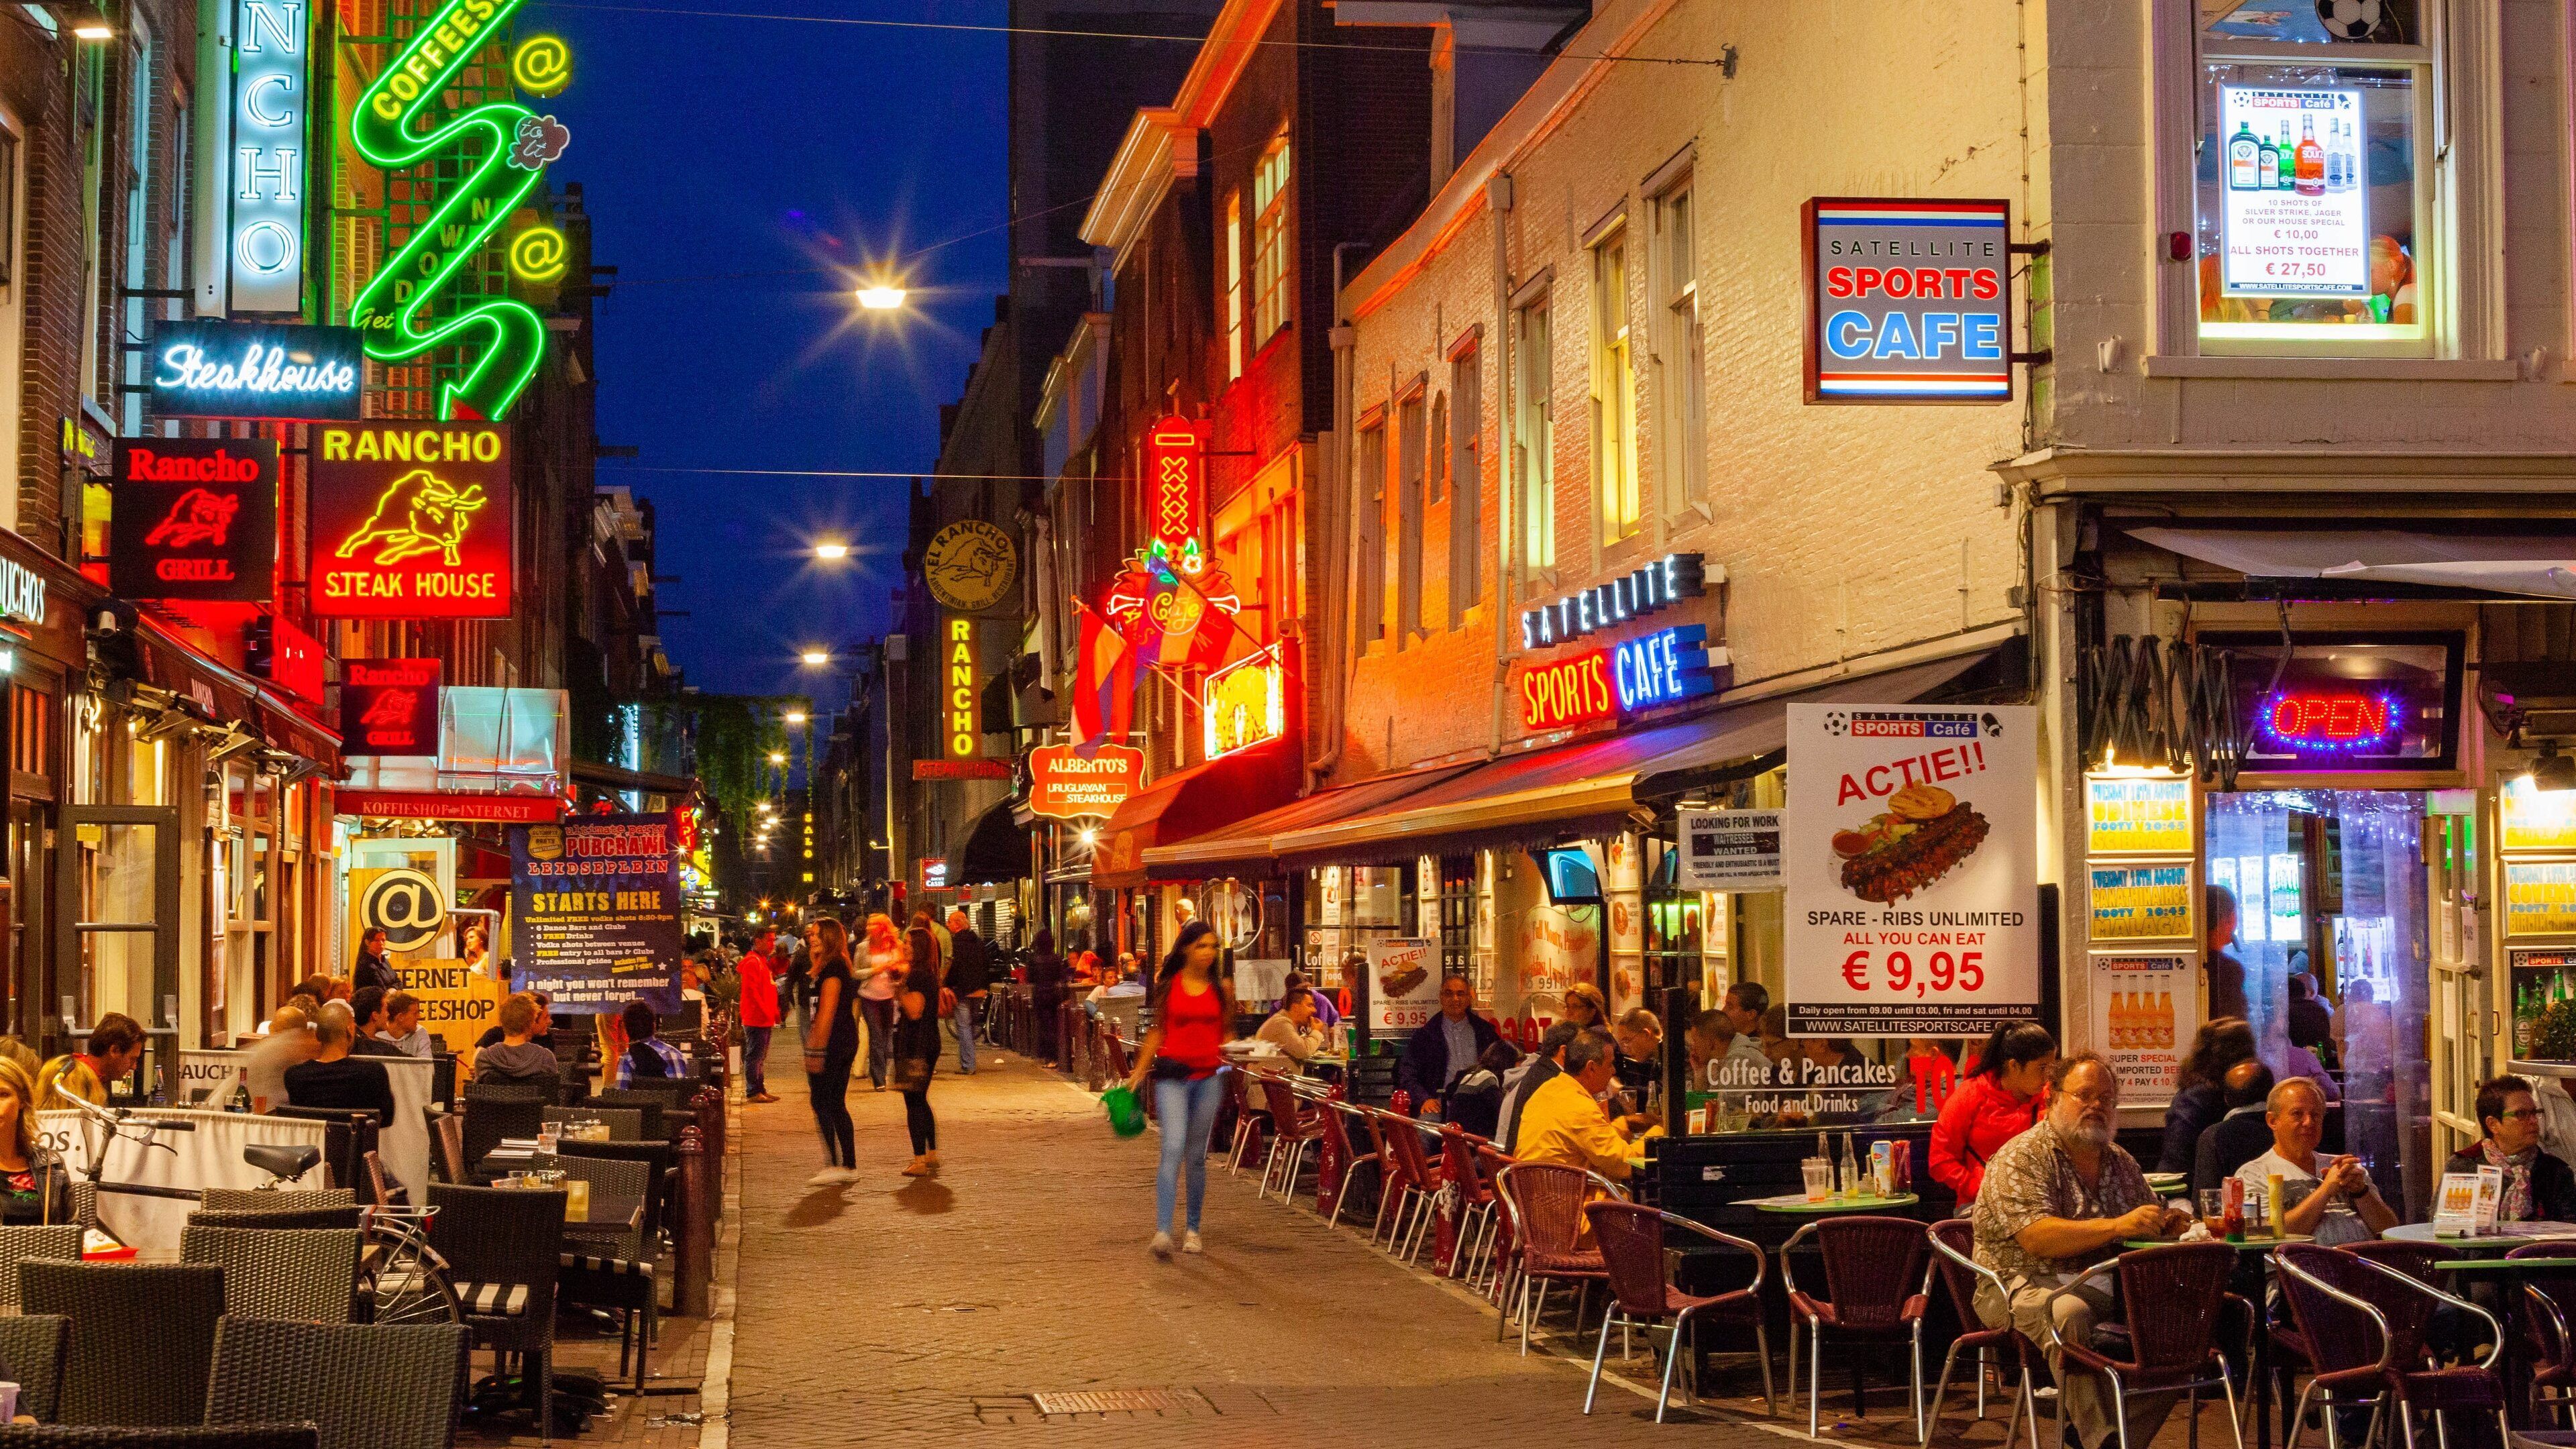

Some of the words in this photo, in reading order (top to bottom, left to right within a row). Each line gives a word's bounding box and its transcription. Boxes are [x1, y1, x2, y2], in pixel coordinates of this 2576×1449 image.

[372, 0, 504, 121] COFFEES
[2254, 99, 2299, 108] SPORTS
[2306, 99, 2331, 109] Café
[2279, 209, 2312, 217] STRIKE,
[2274, 230, 2281, 239] €
[2286, 230, 2318, 240] 10,00
[1831, 239, 1995, 257] SATELLITE
[2231, 246, 2252, 255] ALL
[2255, 246, 2294, 256] SHOTS
[2298, 247, 2359, 256] TOGETHER
[2265, 262, 2275, 276] €
[2281, 262, 2326, 278] 27,50
[1827, 266, 2000, 301] SPORTS
[1826, 310, 2001, 360] CAFE
[156, 344, 354, 393] Steakhouse
[323, 431, 501, 461] RANCHO
[127, 448, 259, 482] Rancho
[936, 523, 1008, 549] RANCHO
[156, 559, 235, 580] GRILL
[325, 572, 402, 598] STEAK
[415, 572, 496, 598] HOUSE
[1522, 555, 1676, 650] SATELLITE
[350, 665, 430, 686] Rancho
[1523, 654, 1609, 726] SPORTS
[1616, 633, 1682, 712] CAFE
[951, 620, 973, 757] RANCHO
[1856, 713, 1974, 721] SATELLITE
[2274, 699, 2386, 737] OPEN
[1855, 723, 1921, 735] SPORTS
[1933, 723, 1971, 736] Café
[367, 731, 415, 745] GRILL
[1048, 758, 1128, 773] ALBERTO'S
[1837, 741, 1986, 806] ACTIE!!
[1047, 784, 1106, 793] URUGUAYAN
[362, 802, 447, 816] KOFFIESHOP
[460, 804, 531, 819] INTERNET
[1690, 817, 1730, 829] LOOKING
[1733, 816, 1750, 828] FOR
[1752, 815, 1778, 827] WORK
[2094, 821, 2133, 831] FOOTY
[2145, 821, 2186, 831] 20:45
[566, 824, 625, 836] ultimate
[628, 824, 667, 838] party
[566, 836, 668, 857] PUBCRAWL
[1713, 833, 1755, 845] WAITRESSES
[1713, 847, 1758, 855] WANTED
[528, 860, 669, 875] LEIDSEPLEIN
[533, 892, 610, 912] STARTS
[616, 891, 661, 910] HERE
[2092, 885, 2188, 908] PANATHINAIKOS
[2094, 908, 2135, 918] FOOTY
[2146, 906, 2186, 917] 20:45
[2510, 904, 2549, 913] FOOTY
[1807, 911, 1867, 926] SPARE
[1882, 912, 1923, 926] RIBS
[1929, 912, 2024, 926] UNLIMITED
[2093, 916, 2189, 938] MALAGA
[1843, 932, 1874, 945] ALL
[1879, 932, 1912, 945] YOU
[1917, 932, 1951, 945] CAN
[1956, 933, 1986, 945] EAT
[1381, 948, 1427, 969] ACTIE!!
[1841, 950, 1870, 991] €
[1886, 951, 1984, 999] 9,95
[527, 980, 535, 990] a
[536, 979, 564, 991] night
[566, 979, 586, 991] you
[587, 978, 616, 989] won't
[617, 977, 670, 988] remember
[553, 992, 572, 1002] but
[572, 991, 602, 1002] never
[1383, 1012, 1393, 1025] €
[1799, 1006, 1821, 1016] Daily
[1823, 1008, 1845, 1016] open
[1847, 1006, 1868, 1014] from
[1869, 1006, 1893, 1014] 09.00
[1894, 1006, 1914, 1014] until
[1943, 1006, 1953, 1014] fri
[1954, 1007, 1971, 1015] and
[1972, 1007, 1986, 1015] sat
[1988, 1006, 2008, 1015] until
[2009, 1007, 2033, 1015] 04.00
[2110, 1055, 2139, 1063] SUPER
[2141, 1055, 2178, 1063] SPECIAL
[1707, 1058, 1772, 1085] Coffee
[1778, 1057, 1794, 1085] &
[1802, 1057, 1896, 1085] Pancakes
[2116, 1066, 2162, 1075] IMPORTED
[2127, 1078, 2133, 1086] 4
[2135, 1077, 2151, 1086] PAY
[2153, 1077, 2158, 1086] €
[1746, 1094, 1779, 1114] Food
[1783, 1094, 1809, 1113] and
[1813, 1093, 1858, 1113] Drinks
